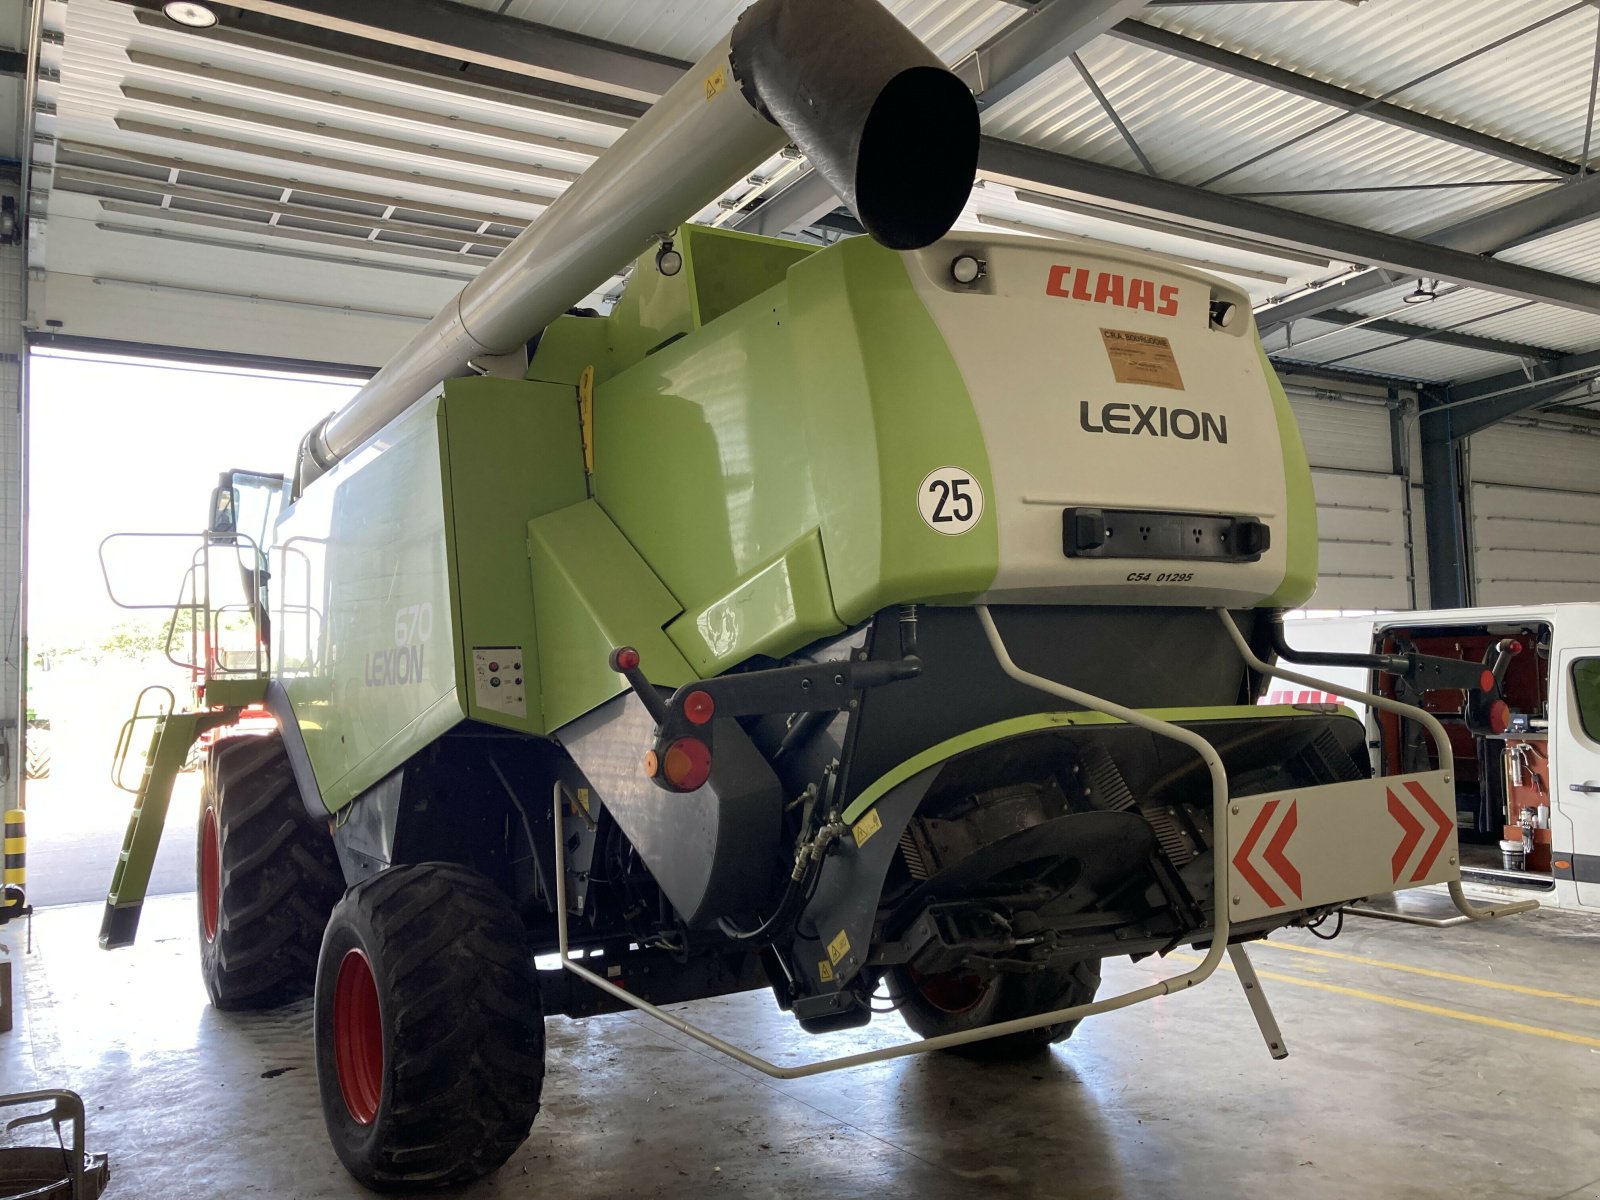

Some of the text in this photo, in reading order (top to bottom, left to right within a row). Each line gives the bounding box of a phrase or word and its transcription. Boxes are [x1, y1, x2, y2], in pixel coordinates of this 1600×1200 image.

[1045, 265, 1179, 317] CLAAS
[1080, 400, 1228, 444] LEXION
[929, 479, 973, 523] 25
[1126, 572, 1194, 582] C54 01295
[395, 602, 433, 646] 670
[365, 644, 424, 687] LEXION
